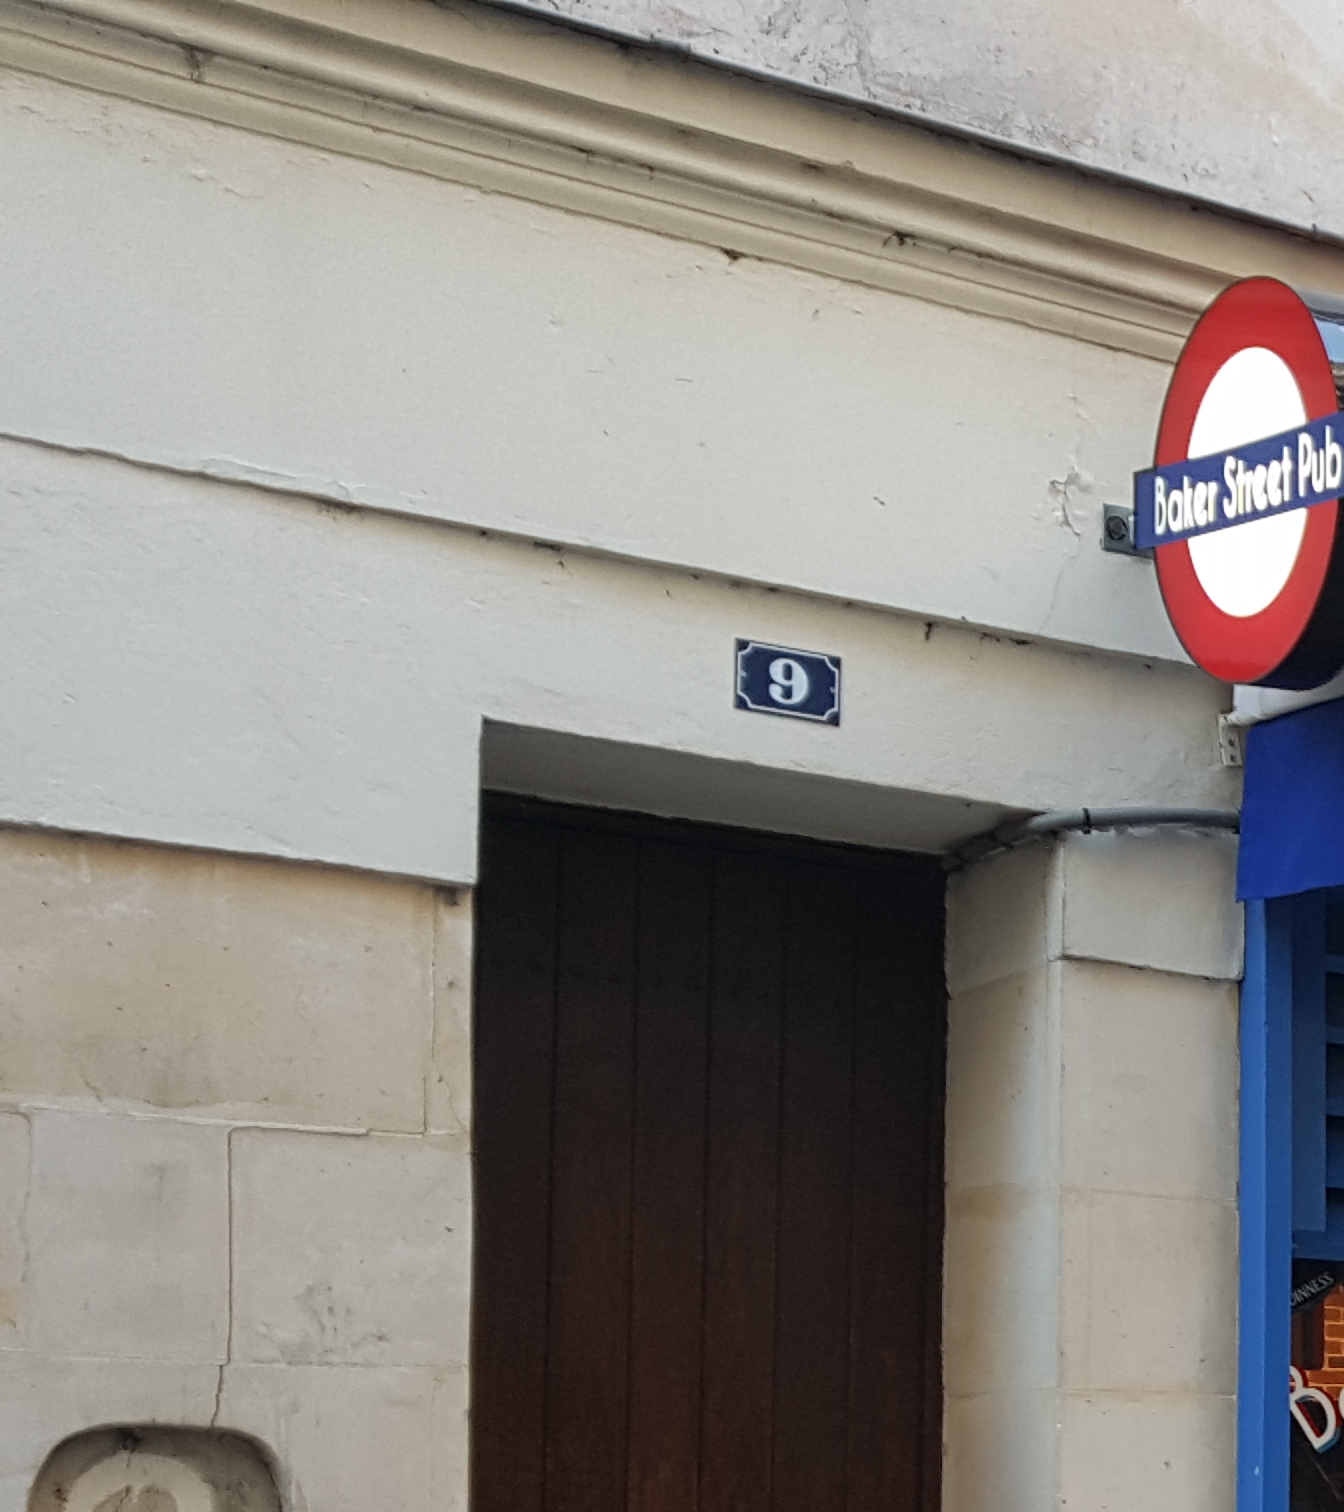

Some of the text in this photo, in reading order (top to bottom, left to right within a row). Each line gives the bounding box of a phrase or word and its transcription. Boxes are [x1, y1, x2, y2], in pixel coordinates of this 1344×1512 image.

[1154, 425, 1343, 536] Baker Street Pub
[769, 658, 808, 705] 9
